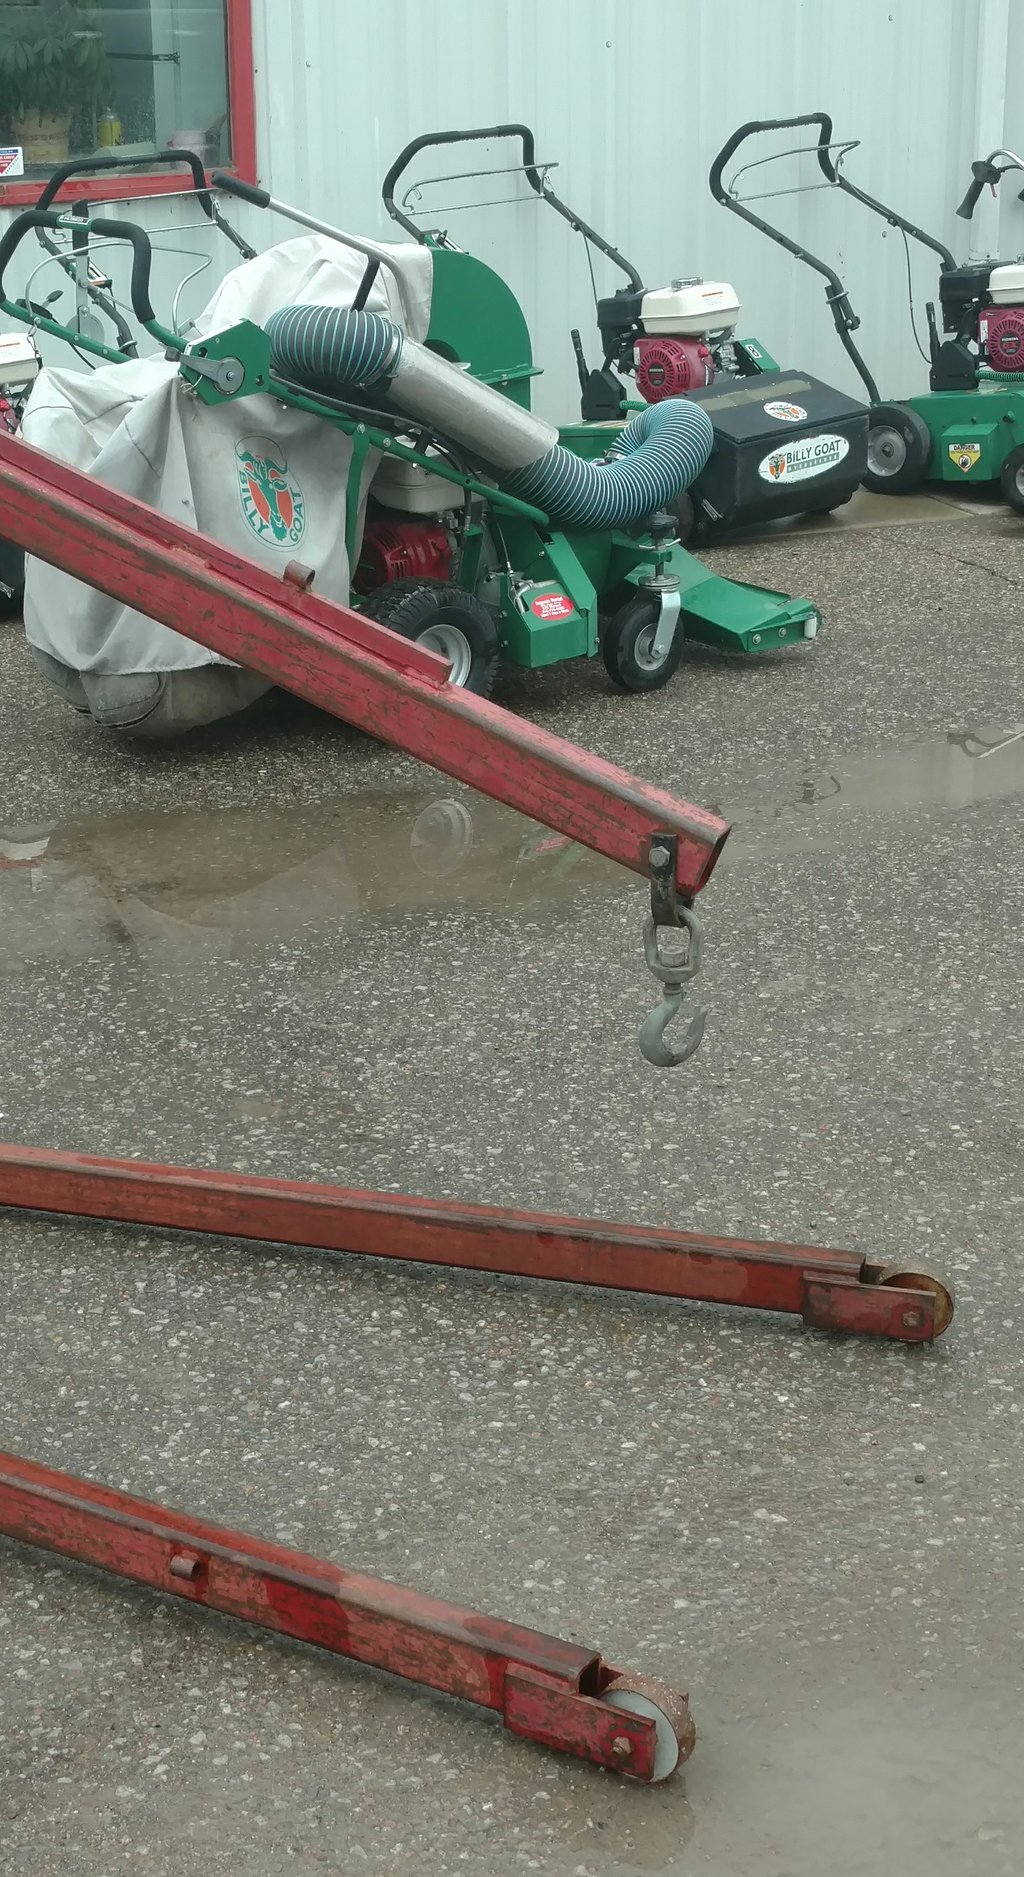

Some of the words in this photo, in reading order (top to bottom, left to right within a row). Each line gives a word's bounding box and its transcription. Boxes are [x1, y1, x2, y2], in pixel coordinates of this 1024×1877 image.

[787, 447, 812, 464] BILLY
[815, 440, 841, 456] GOAT
[239, 470, 269, 533] BILLY
[289, 488, 303, 542] GOAT
